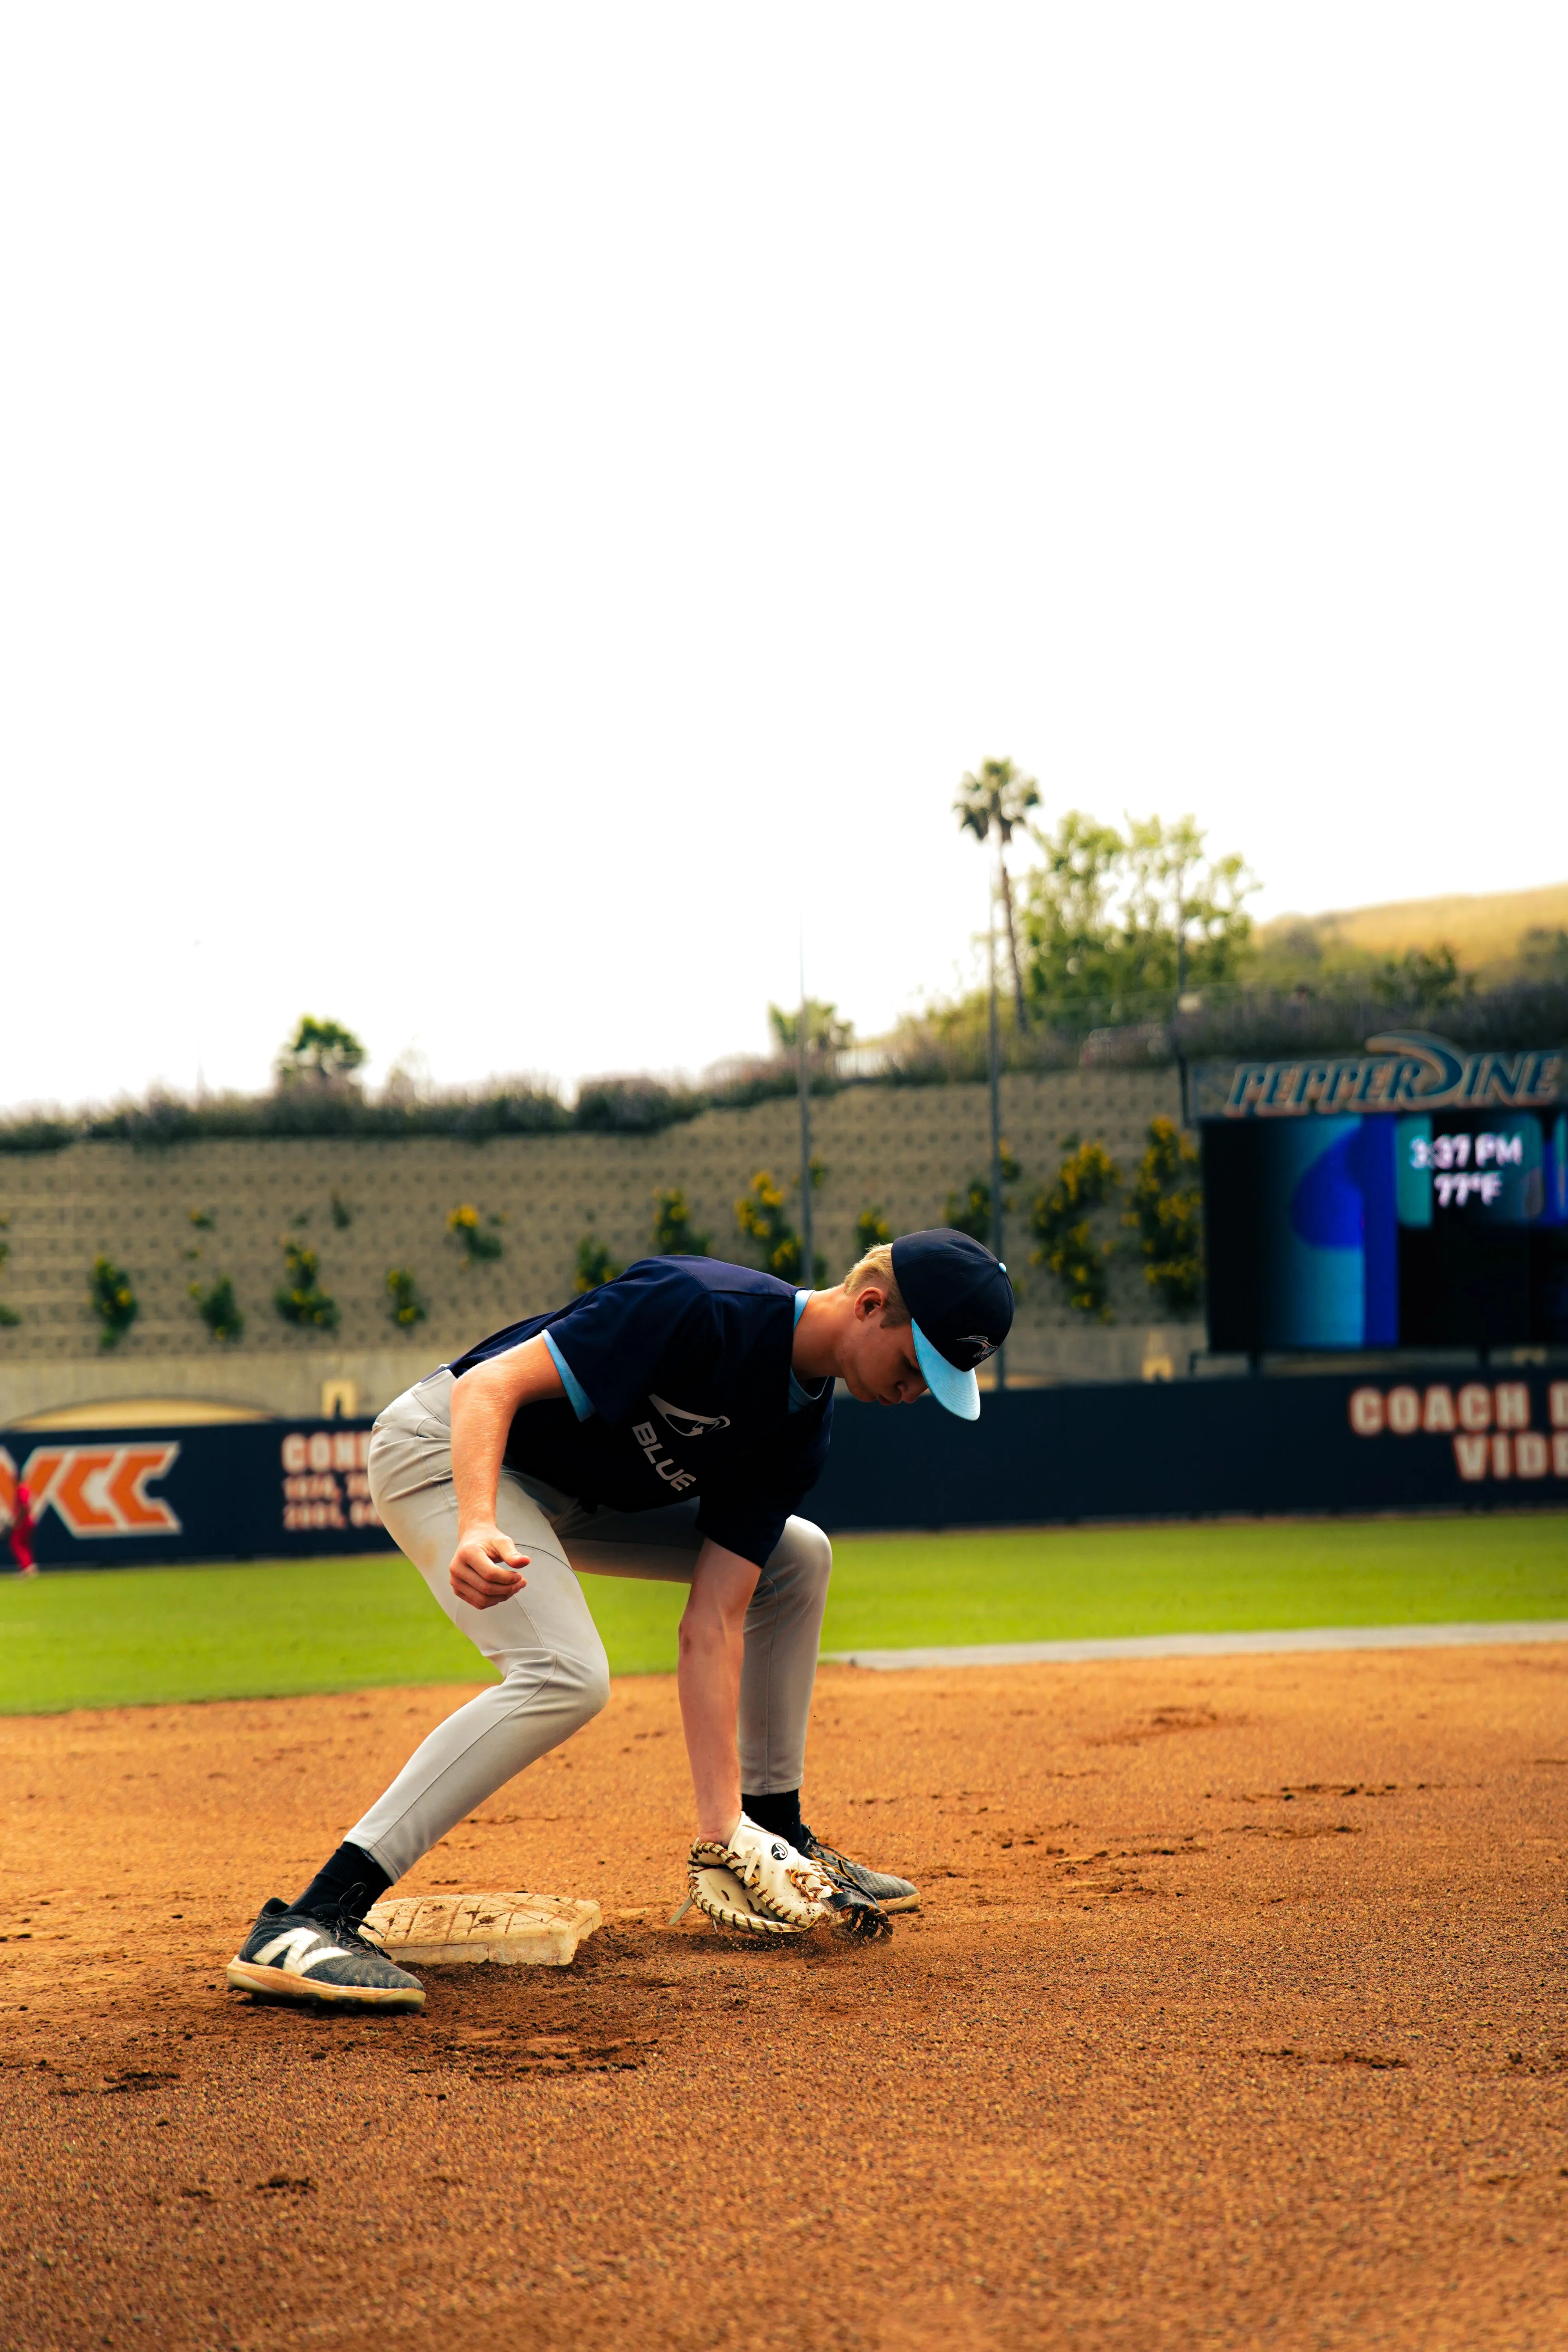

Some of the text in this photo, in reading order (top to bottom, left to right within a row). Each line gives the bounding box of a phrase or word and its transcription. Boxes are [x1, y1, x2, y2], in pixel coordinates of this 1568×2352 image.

[1223, 1030, 1563, 1117] PEPPERDINE
[1475, 1133, 1523, 1167] PM
[1349, 1381, 1530, 1437] COACH
[631, 1421, 697, 1491] BLUE
